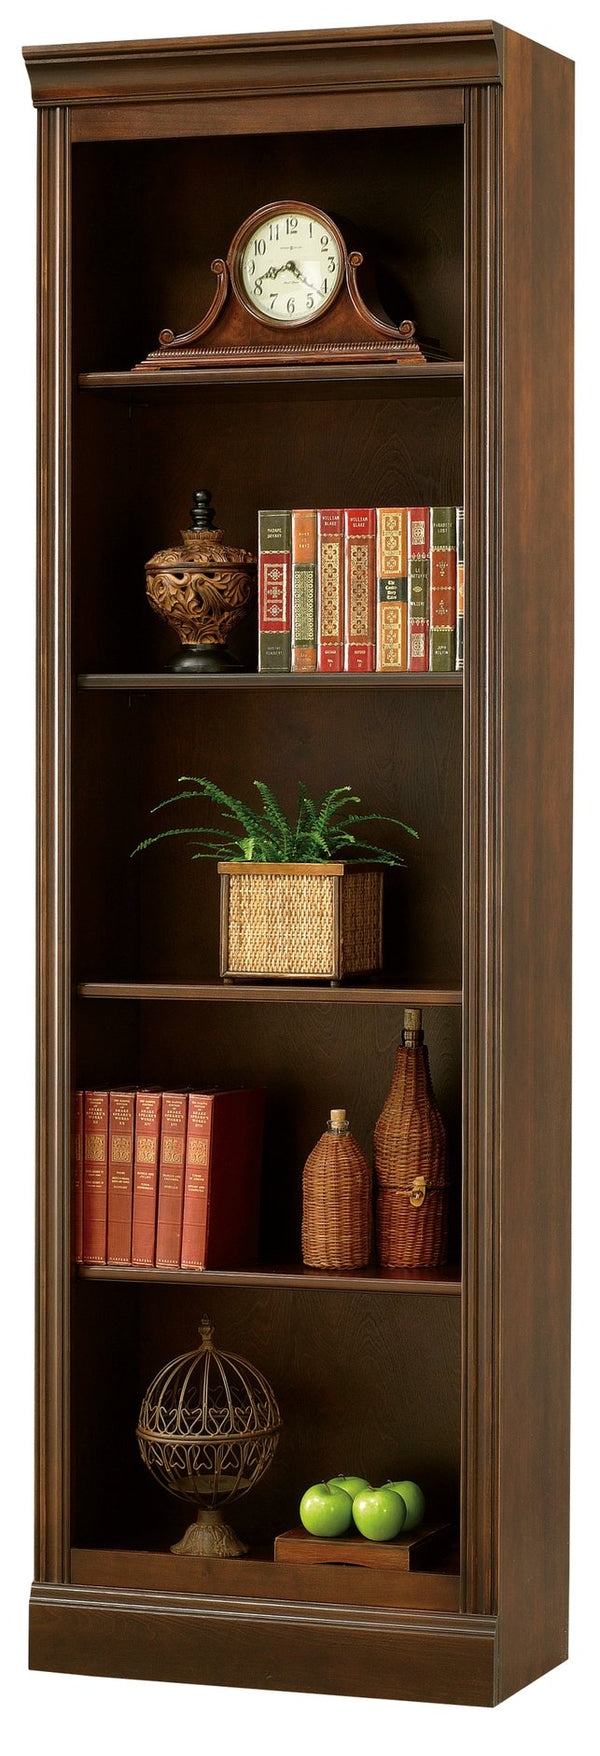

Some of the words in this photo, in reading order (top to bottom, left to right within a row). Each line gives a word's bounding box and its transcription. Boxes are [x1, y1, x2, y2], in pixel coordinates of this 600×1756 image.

[269, 224, 279, 241] 11
[286, 218, 298, 235] 12
[309, 222, 313, 238] 1
[254, 239, 266, 256] 10
[320, 235, 329, 252] 2
[248, 259, 255, 276] 9
[328, 256, 336, 273] 3
[253, 278, 263, 295] 8
[321, 278, 328, 294] 4
[269, 293, 279, 310] 7
[287, 297, 295, 314] 6
[306, 293, 314, 309] 5
